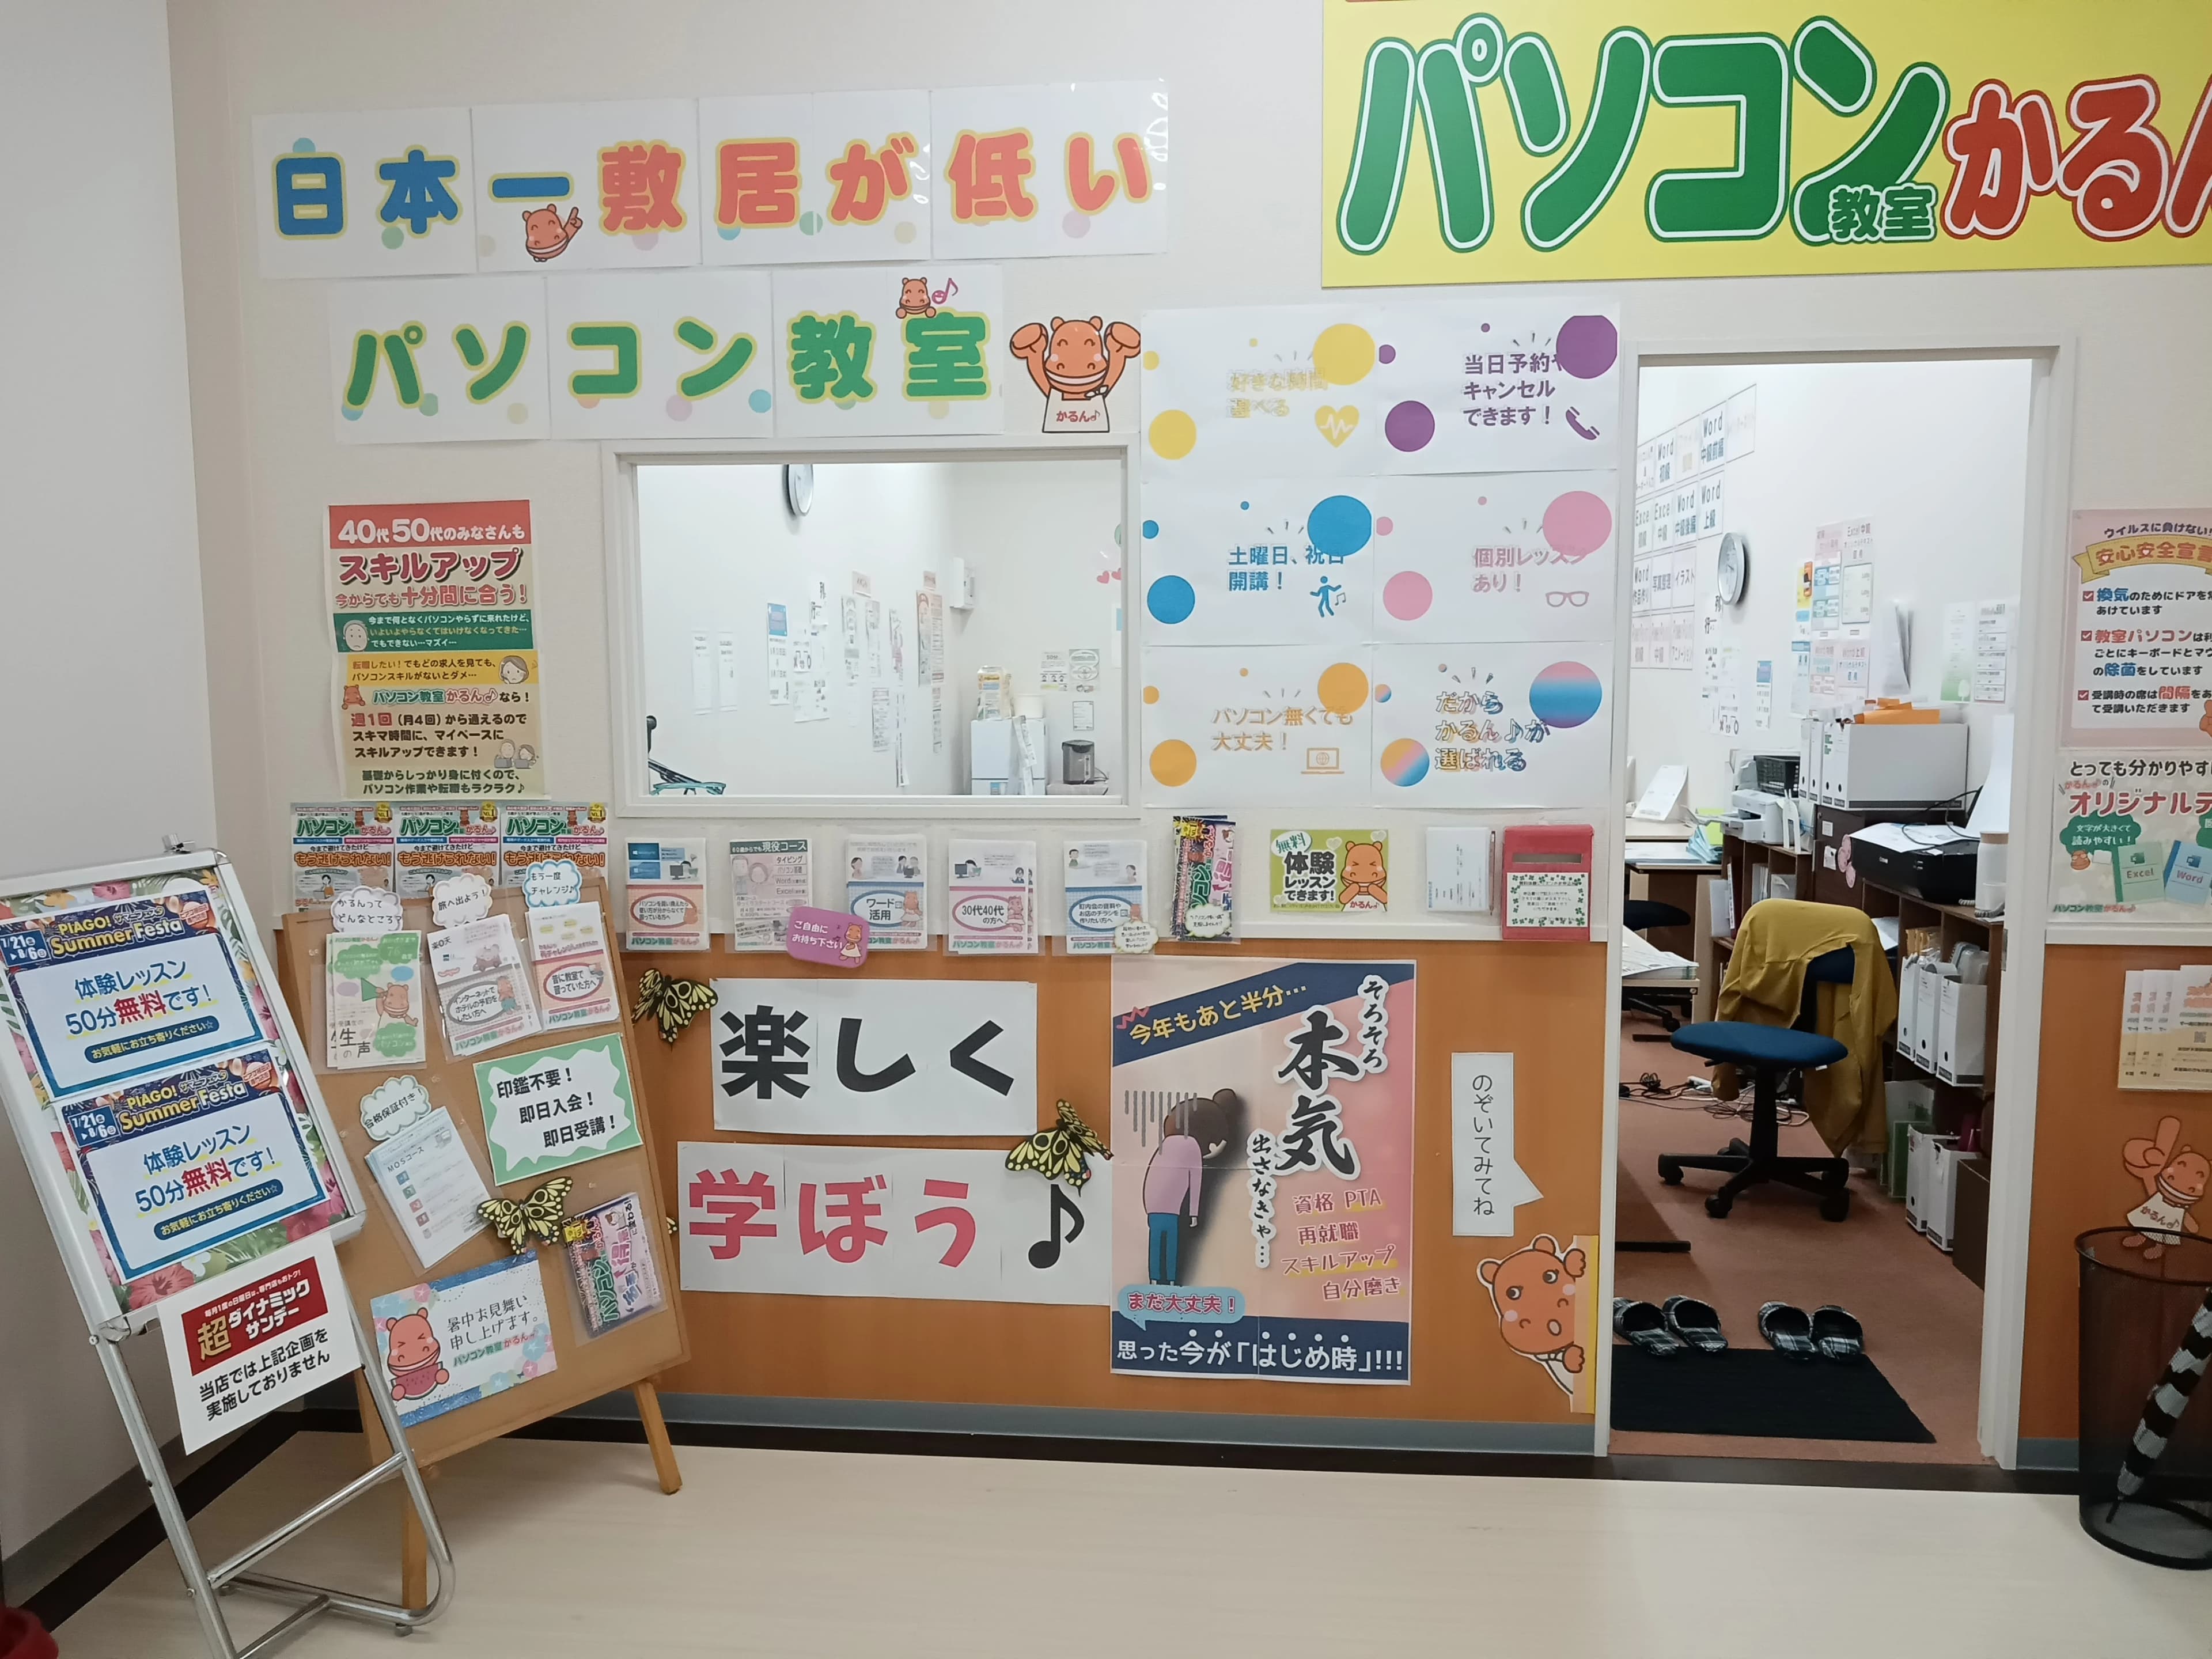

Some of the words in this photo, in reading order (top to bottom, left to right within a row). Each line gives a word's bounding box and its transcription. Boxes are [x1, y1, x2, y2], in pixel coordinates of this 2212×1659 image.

[1335, 11, 1949, 254] パソコン
[1826, 183, 1937, 244] 教室
[273, 129, 1151, 240] 日本一敷居が低い
[344, 308, 989, 407] パソコン教室
[1463, 378, 1556, 399] キャンセル
[1226, 397, 1290, 419] 選べる
[1462, 406, 1552, 427] できます！
[337, 517, 525, 544] 40代50代のみなさんも
[338, 547, 523, 585] スキルアップ
[1472, 545, 1586, 567] 個別レッスン
[1228, 570, 1284, 593] 開講！
[1472, 573, 1522, 594] あり！
[2096, 605, 2163, 616] あけています
[2093, 662, 2203, 677] の除菌をしています
[1435, 691, 1504, 715] だから
[2092, 703, 2191, 714] て受講いただきます
[1211, 705, 1354, 726] パソコン無くても
[1211, 731, 1289, 752] 大丈夫！
[1434, 748, 1528, 772] 選ばれる
[2070, 759, 2212, 777] とっても分かりやす
[2071, 835, 2133, 846] 読みやすい！
[2076, 824, 2132, 833] 文字が大きくて
[1276, 832, 1306, 854] 無料
[1285, 851, 1335, 875] 体験
[2126, 868, 2154, 879] Excel
[531, 871, 562, 881] もう一度
[1285, 876, 1336, 889] レッスン
[2176, 869, 2205, 884] Word
[337, 899, 383, 909] かるんって
[866, 898, 895, 908] ワード
[962, 905, 1005, 916] 30代40代
[58, 915, 112, 937] PIAGO!
[794, 921, 829, 934] ご自由に
[869, 910, 892, 921] 活用
[50, 927, 134, 958] Summer
[133, 918, 184, 941] Festa
[791, 933, 843, 950] お持ち下さい
[75, 960, 187, 1001] 体験レッスン
[1362, 979, 1384, 1069] そろそろ
[718, 1005, 1014, 1100] 楽しく
[495, 1068, 574, 1101] 印鑑不要！
[1277, 1009, 1360, 1175] 本気
[119, 1097, 199, 1132] Summer
[198, 1082, 248, 1107] Festa
[127, 1085, 178, 1110] PIAGO!
[518, 1091, 596, 1124] 即日入会！
[542, 1114, 618, 1149] 即日受講！
[143, 1124, 251, 1176] 体験レッスン
[1472, 1074, 1495, 1217] のぞいてみてね
[1293, 1192, 1335, 1215] 資格
[1345, 1187, 1383, 1209] PTA
[1298, 1221, 1360, 1245] 再就職
[1281, 1244, 1397, 1275] スキルアップ
[1323, 1277, 1402, 1300] 自分磨き
[228, 1278, 310, 1330] ダイナミック
[446, 1294, 529, 1333] 暑中お見舞い
[1128, 1291, 1236, 1314] まだ大丈夫！
[245, 1306, 300, 1339] サンデー
[449, 1313, 540, 1351] 申し上げます。
[197, 1315, 232, 1361] 超
[199, 1327, 329, 1403] 当店では上記企画を
[206, 1350, 330, 1422] 実施しておりません
